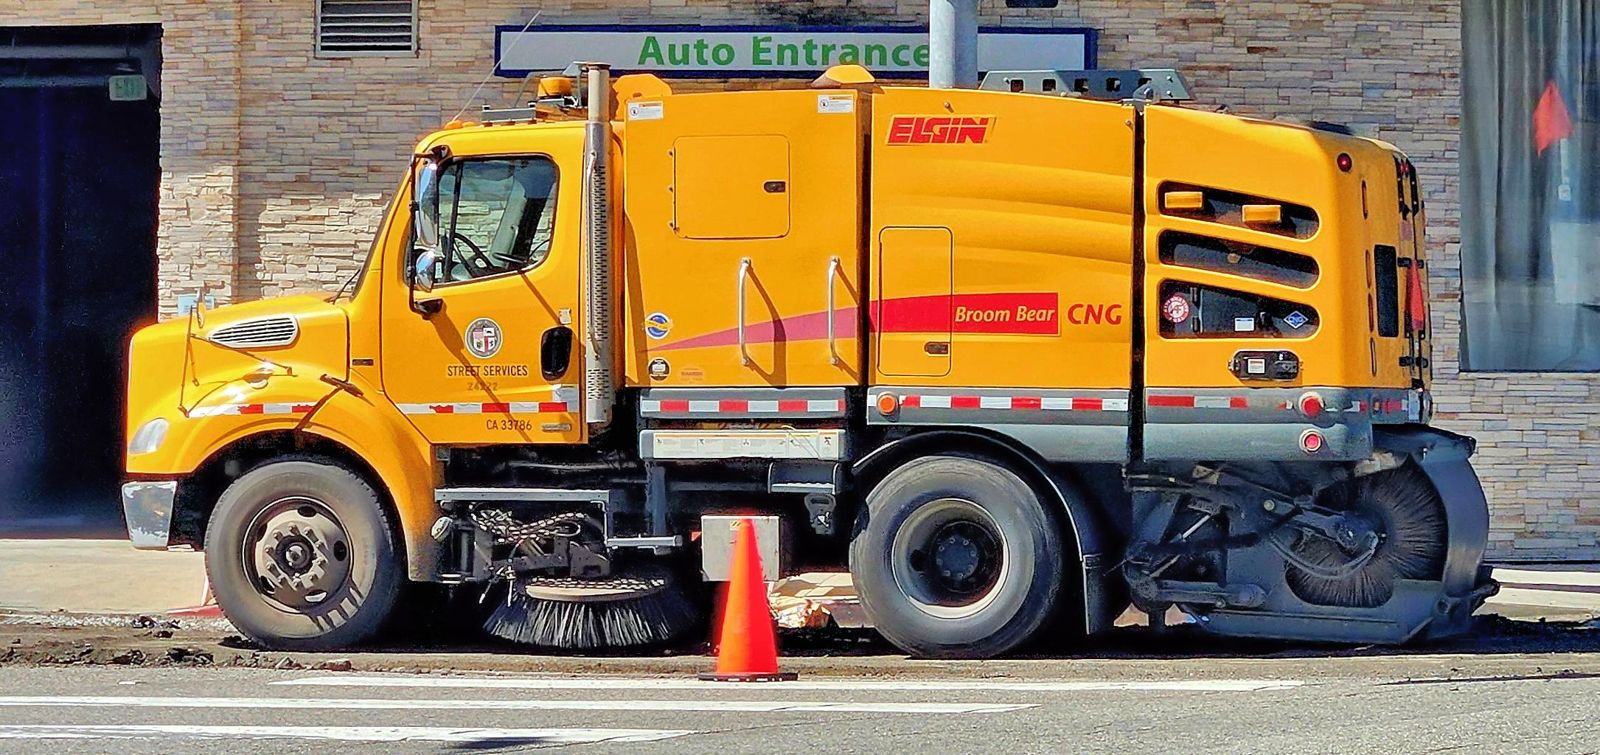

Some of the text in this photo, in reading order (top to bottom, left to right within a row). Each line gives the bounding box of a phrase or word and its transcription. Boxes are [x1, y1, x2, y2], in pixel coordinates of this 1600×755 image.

[637, 36, 929, 65] Auto Entrance
[888, 117, 989, 144] ELGIN
[955, 305, 1056, 322] Broom Bear
[1067, 303, 1122, 325] CNG
[447, 365, 528, 377] STREET SERVICES
[486, 419, 499, 431] CA
[501, 419, 532, 431] 33786
